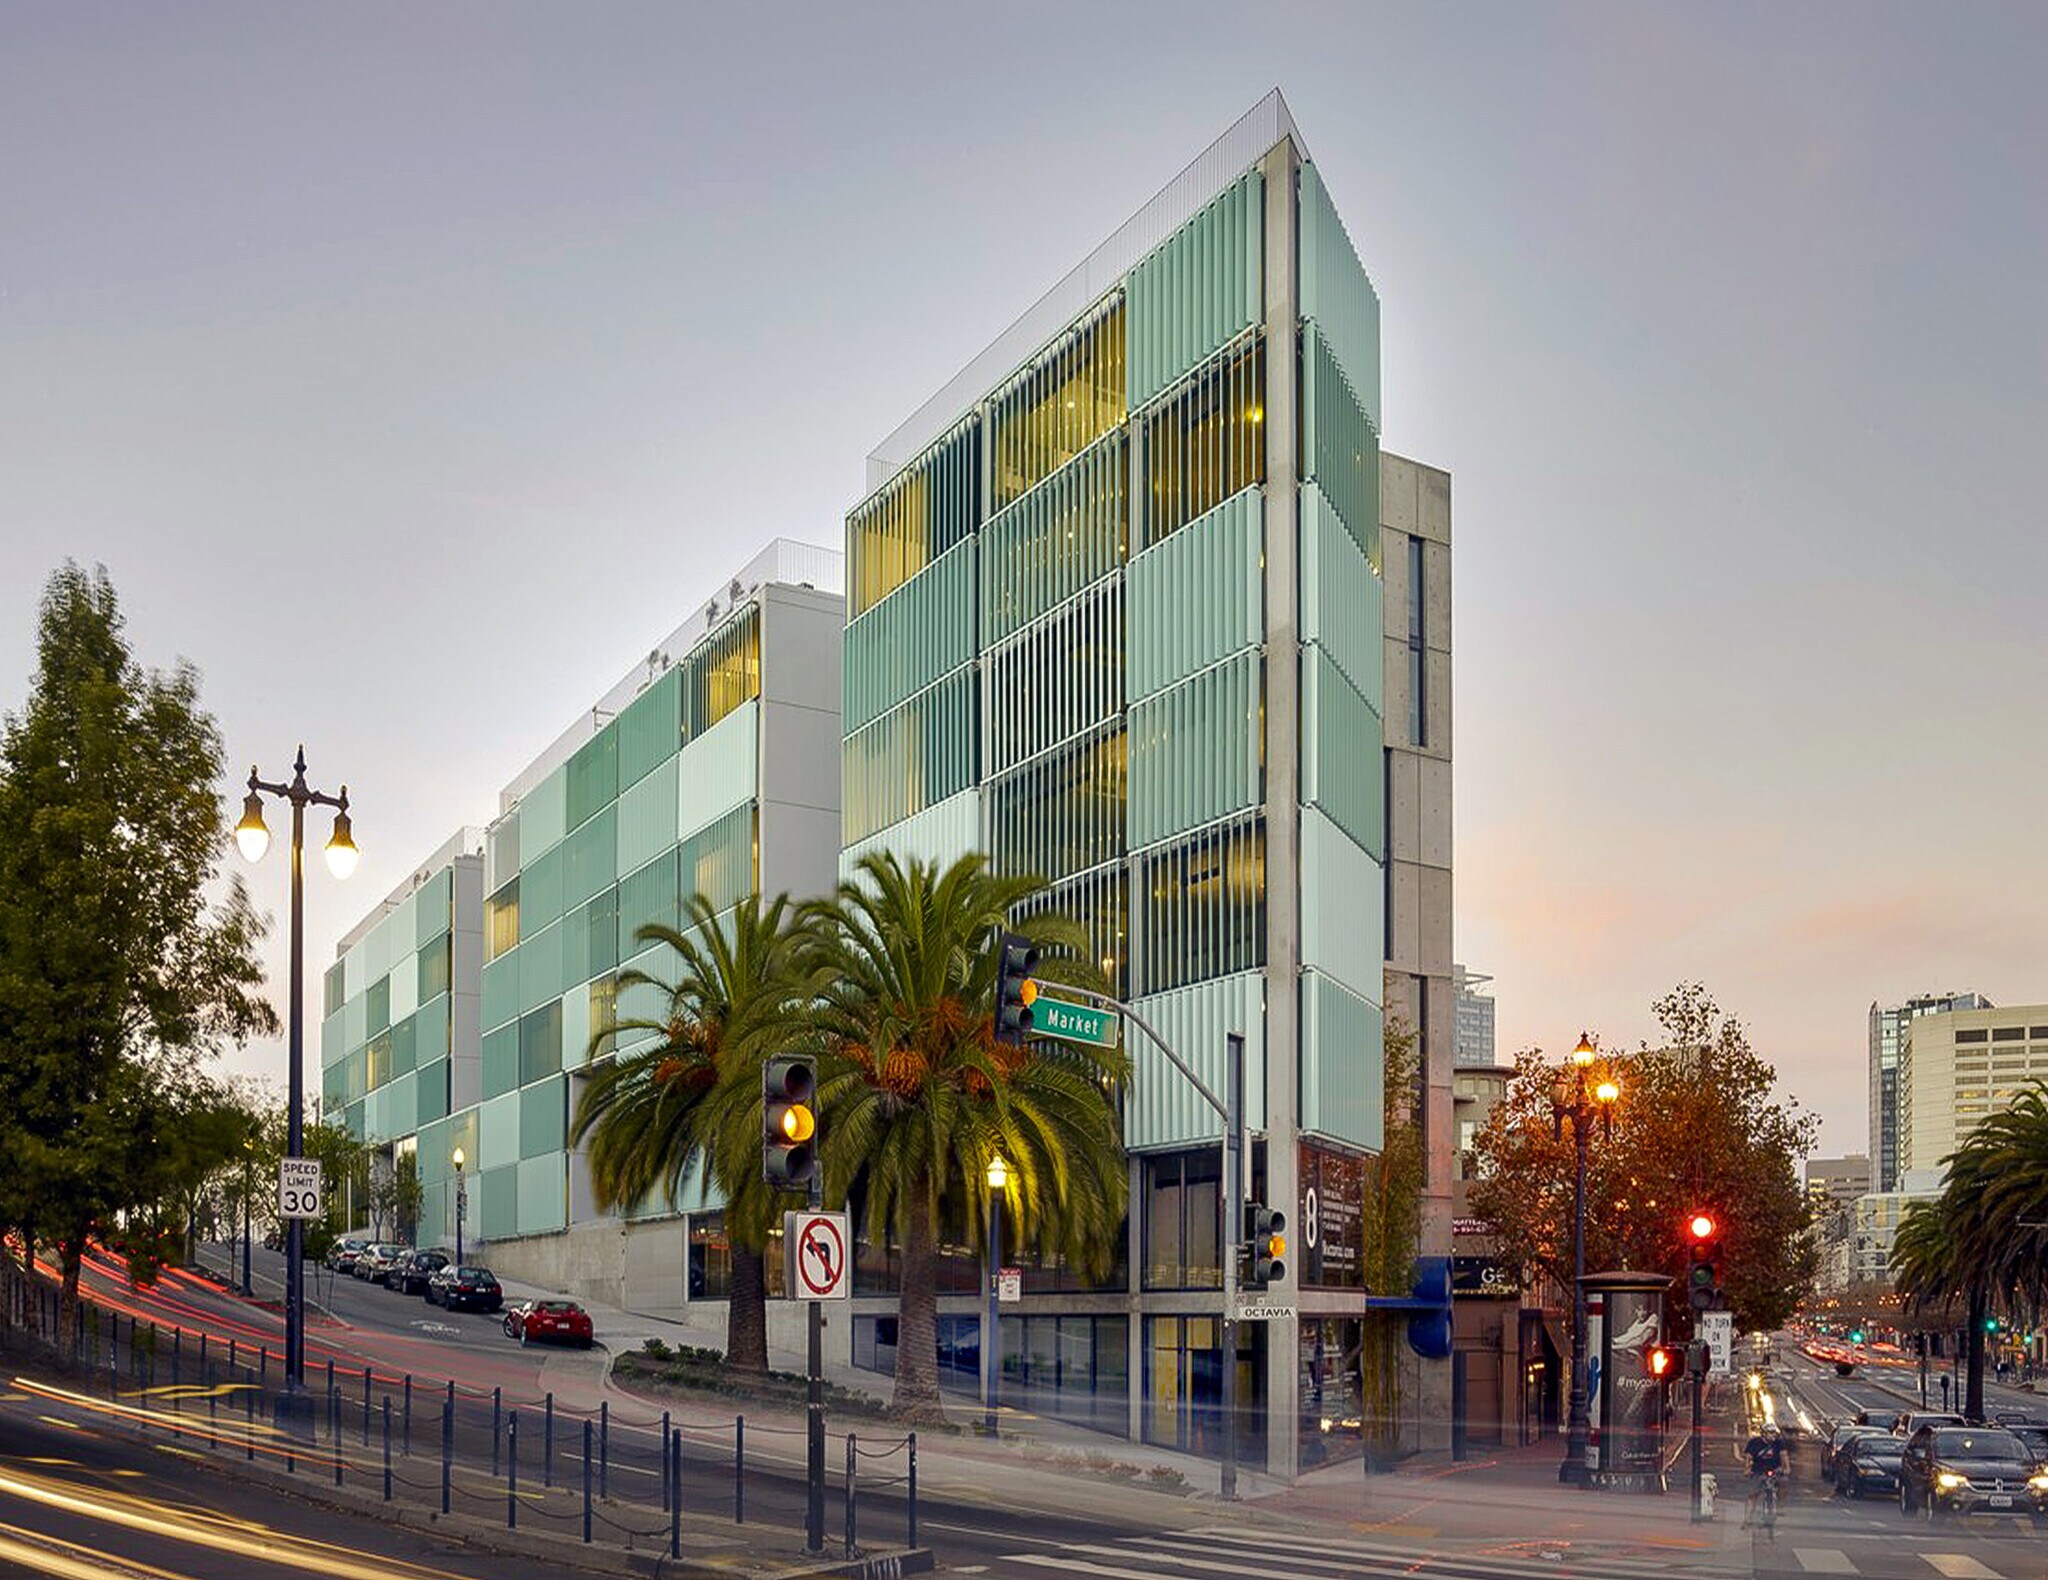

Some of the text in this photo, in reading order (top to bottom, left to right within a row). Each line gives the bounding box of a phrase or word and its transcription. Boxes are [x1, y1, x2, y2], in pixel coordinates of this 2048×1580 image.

[1047, 1008, 1098, 1035] Market
[283, 1162, 318, 1175] SPEED
[287, 1176, 314, 1188] LIMIT
[284, 1190, 318, 1213] 30
[1306, 1187, 1318, 1249] 8
[1245, 1308, 1291, 1317] OCTAVIA
